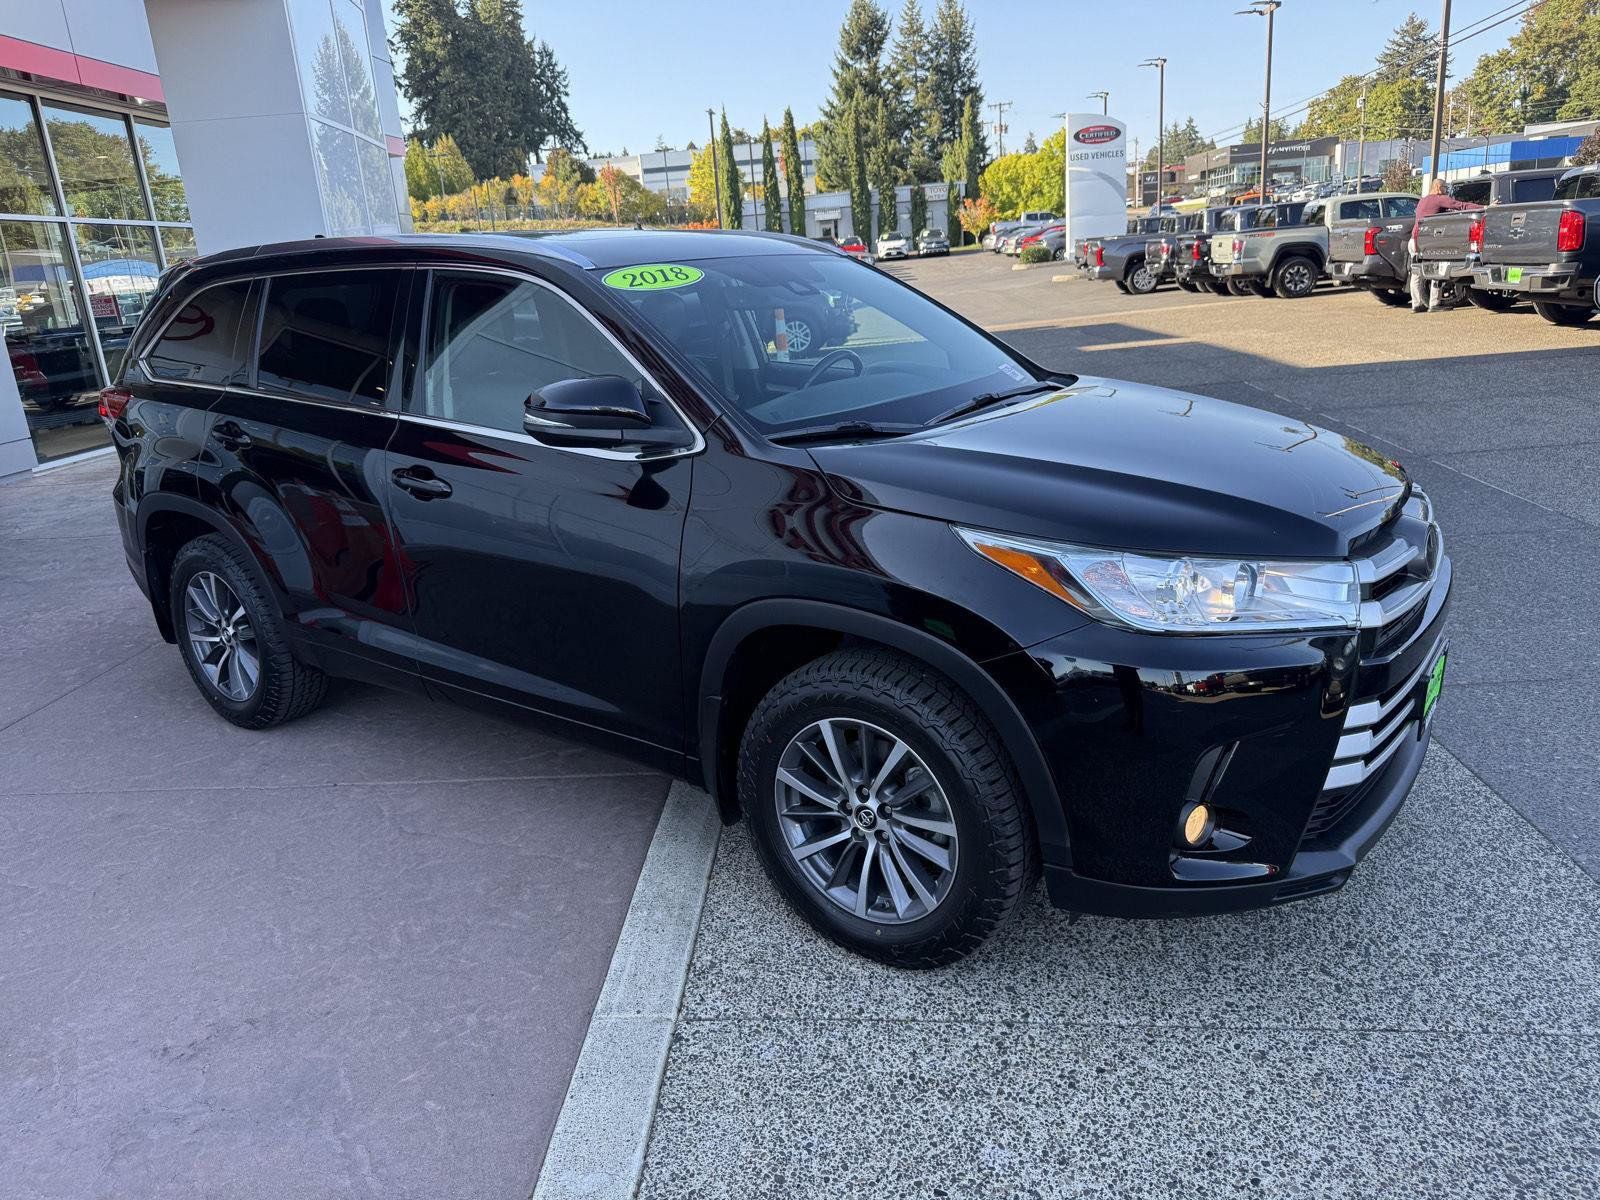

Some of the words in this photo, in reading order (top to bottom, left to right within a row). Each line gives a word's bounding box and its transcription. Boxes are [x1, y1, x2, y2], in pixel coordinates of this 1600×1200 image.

[1079, 130, 1117, 139] CERTIFIED
[1070, 152, 1089, 162] USED
[1091, 150, 1124, 161] VEHICLES
[622, 267, 690, 288] 2018
